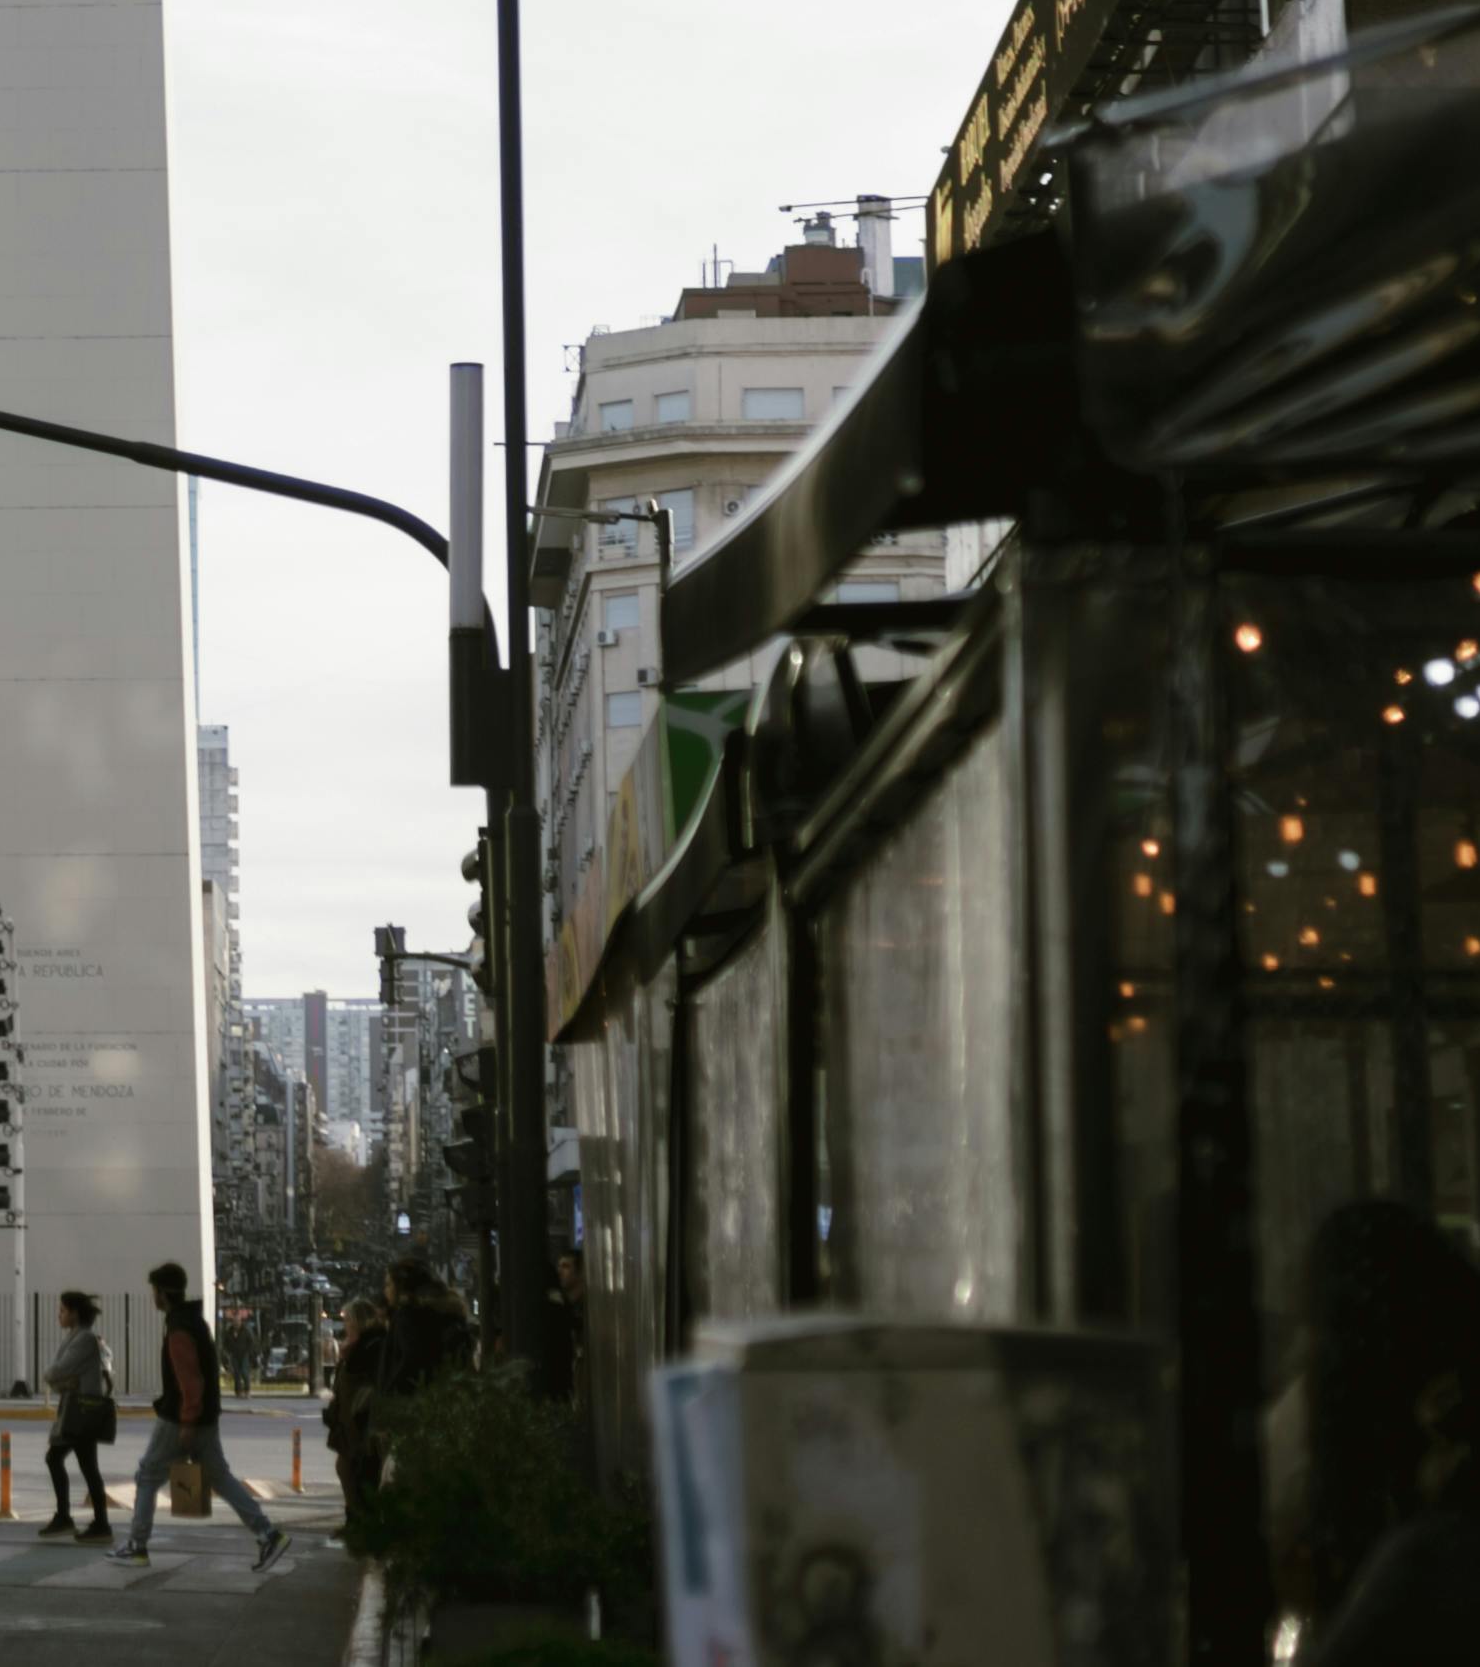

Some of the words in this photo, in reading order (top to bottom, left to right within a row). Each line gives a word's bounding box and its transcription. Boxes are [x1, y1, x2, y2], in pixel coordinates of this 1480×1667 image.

[33, 963, 104, 977] REPUBLICA
[48, 1085, 65, 1099] DE
[71, 1084, 135, 1099] MENDOZA
